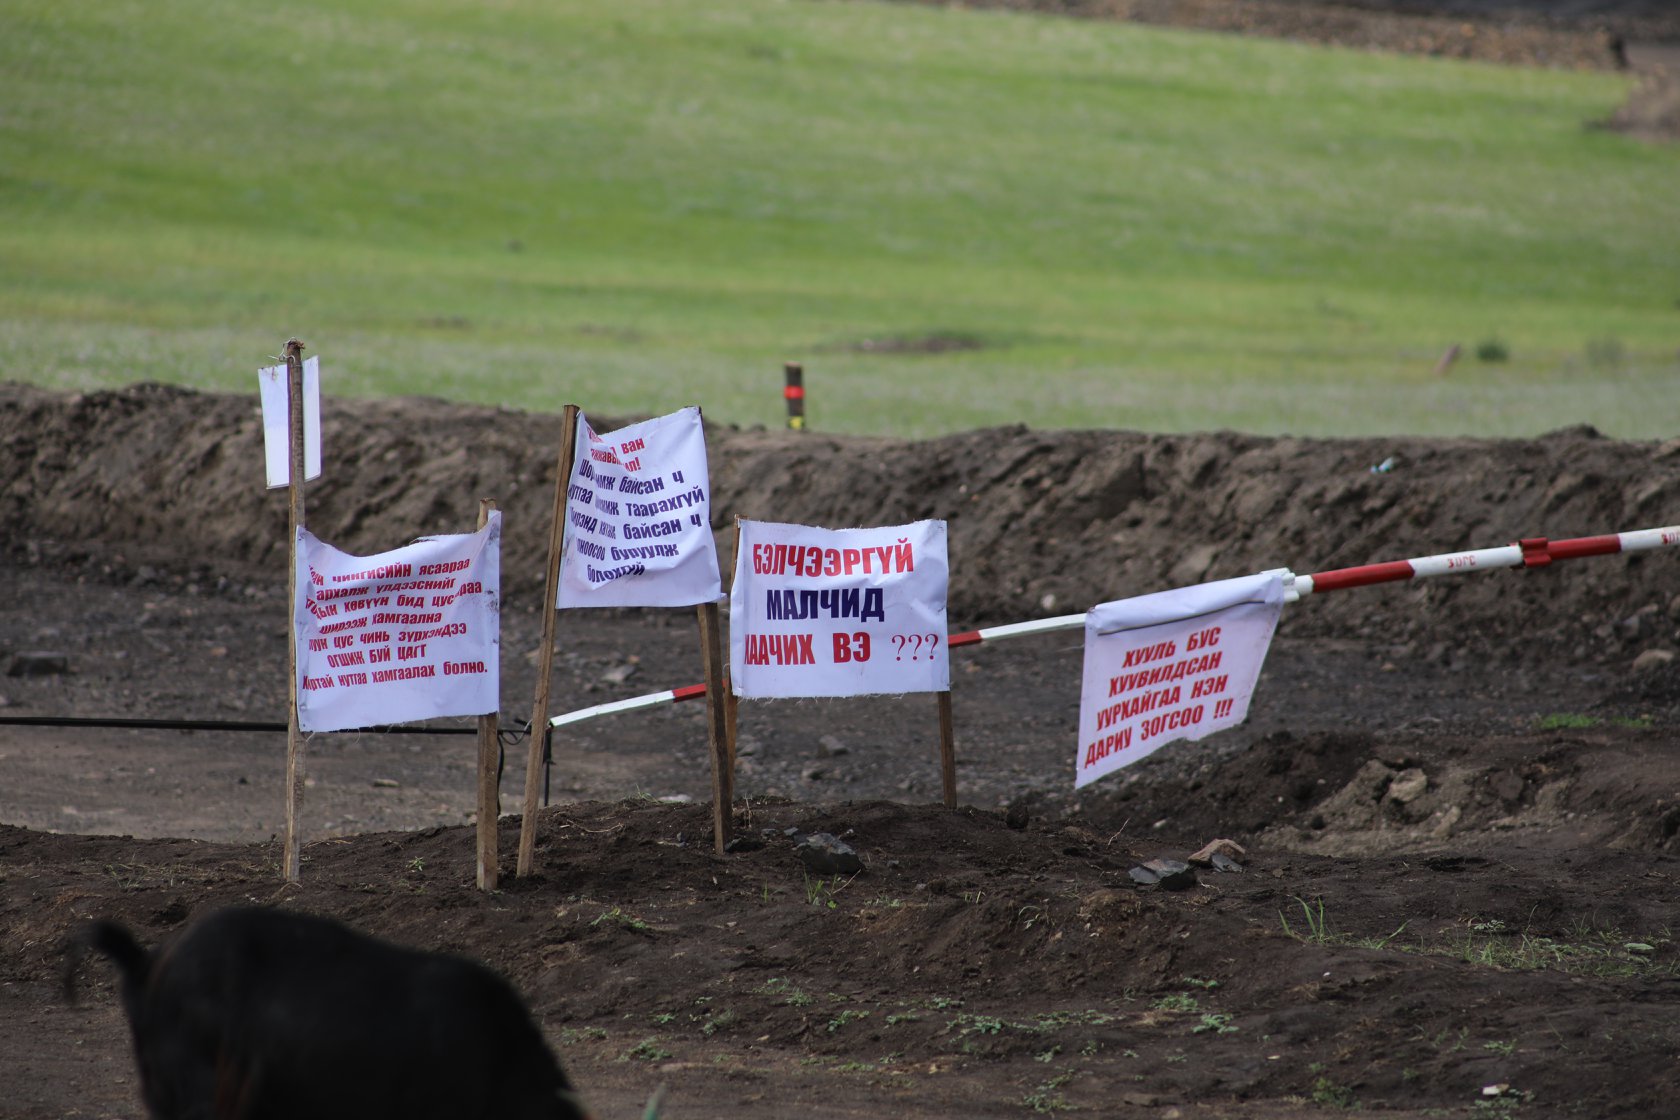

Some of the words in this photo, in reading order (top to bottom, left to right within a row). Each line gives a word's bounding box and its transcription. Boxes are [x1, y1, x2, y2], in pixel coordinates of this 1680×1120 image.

[621, 438, 645, 454] ван
[623, 519, 682, 540] байсан
[753, 537, 914, 577] БЭЛЧЭЭРГҮЙ
[396, 594, 425, 609] бид
[766, 588, 885, 623] МАЛЧИД
[371, 612, 442, 626] хамгаална
[832, 631, 871, 664] ВЭ
[891, 633, 939, 662] ???
[1122, 640, 1176, 669] ХУУЛЬ
[1186, 626, 1222, 653] БУС
[371, 664, 436, 684] хамгаалах
[442, 660, 488, 676] болно.
[1096, 685, 1182, 732] УУРХАЙГАА
[1190, 674, 1229, 700] НЭН
[1083, 727, 1132, 769] ДАРИУ
[1140, 704, 1204, 741] ЗОГСОО
